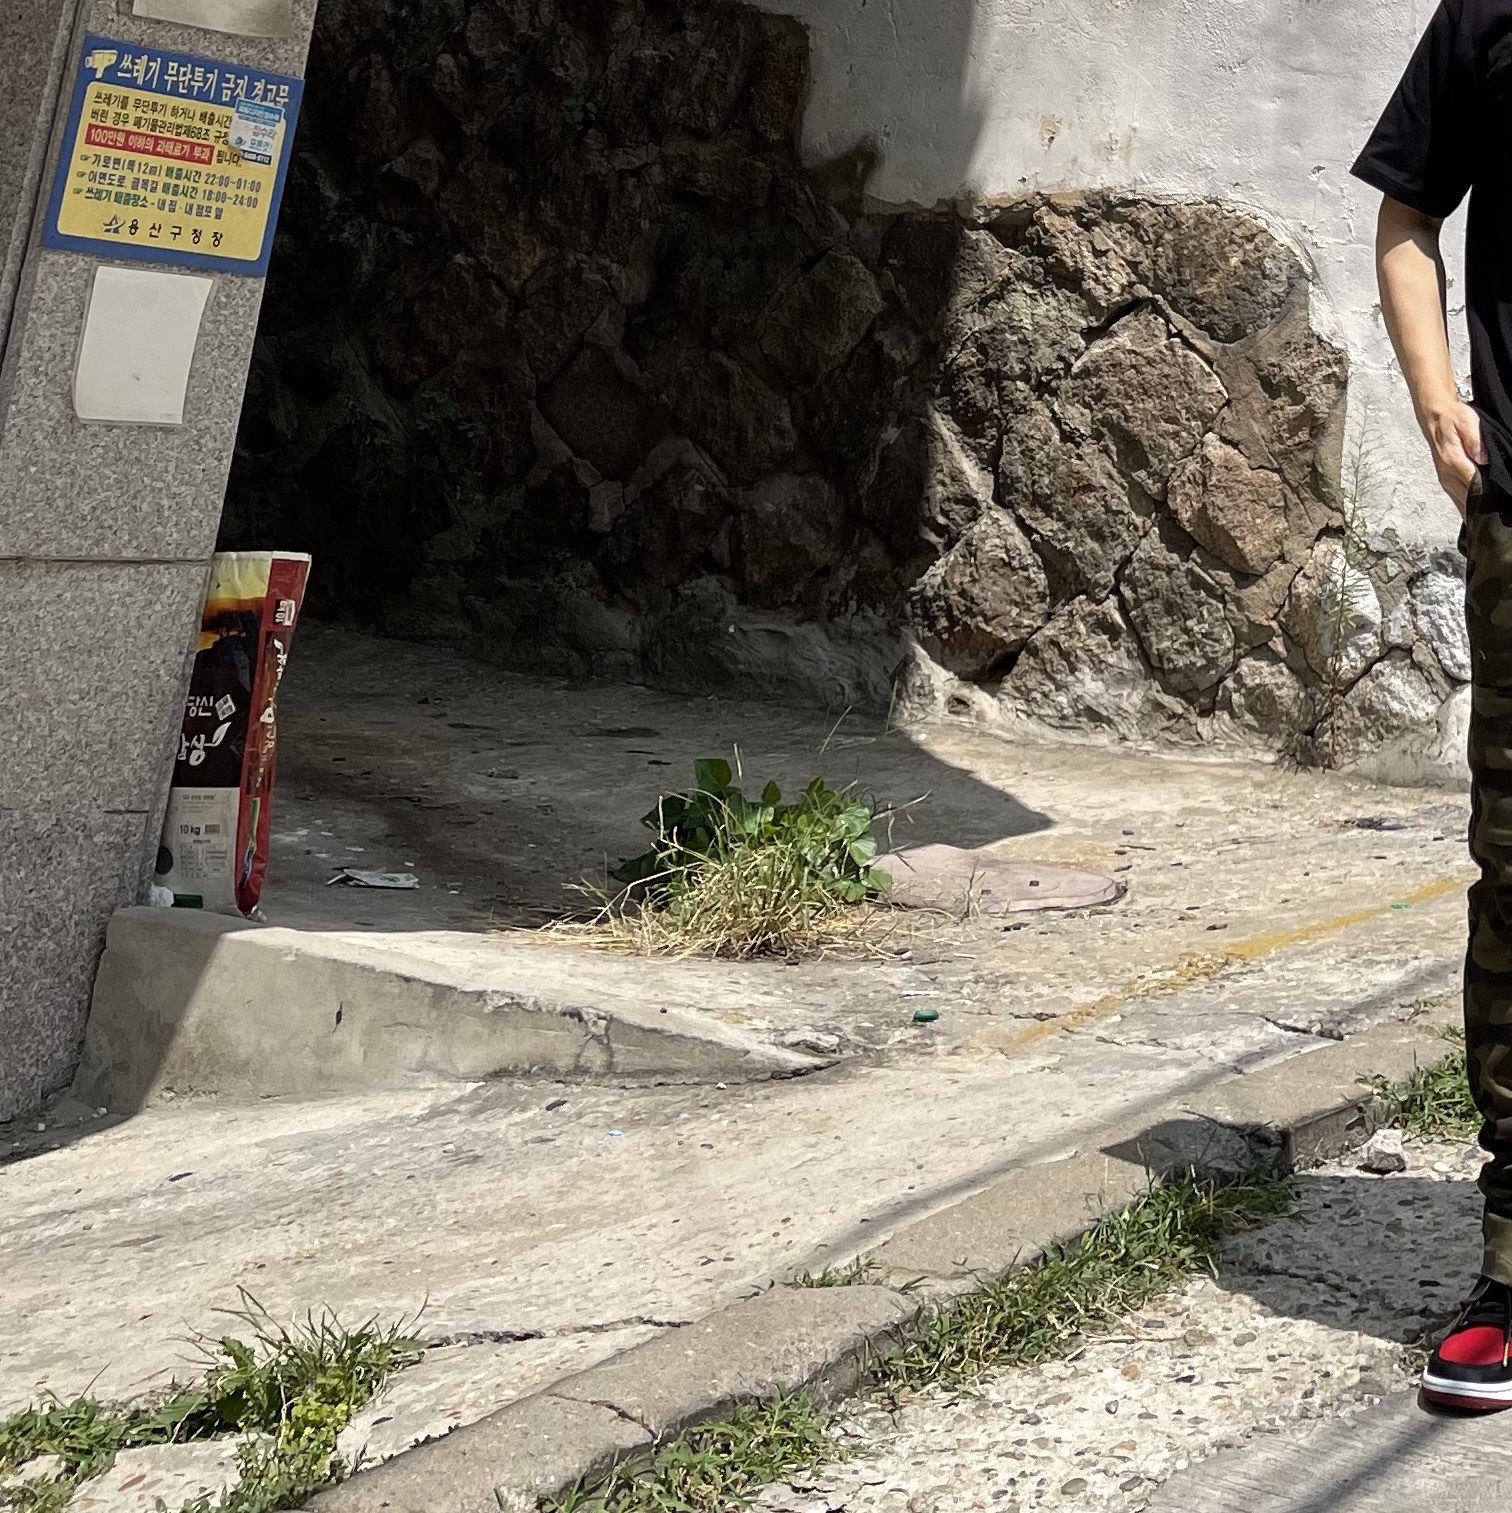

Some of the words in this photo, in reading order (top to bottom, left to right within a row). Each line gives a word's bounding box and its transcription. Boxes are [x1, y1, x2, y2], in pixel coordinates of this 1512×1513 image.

[117, 53, 161, 89] 쓰레기
[164, 61, 218, 100] 무단투기
[221, 72, 248, 102] 금지
[90, 107, 109, 124] 버린
[112, 111, 130, 126] 경우
[93, 91, 130, 110] 쓰레기를
[132, 98, 168, 118] 무단투기
[199, 111, 232, 129] 배출시간
[89, 128, 125, 147] 100만원
[128, 135, 154, 151] 이하의
[193, 146, 210, 161] 부과
[84, 186, 112, 203] 쓰레기
[130, 176, 159, 194] 골목길
[162, 182, 199, 199] 배출시간
[202, 188, 259, 209] 18:00~24:00
[165, 166, 202, 184] 배출시간
[204, 172, 262, 194] 22:00~01:00
[179, 824, 189, 834] 10
[191, 824, 201, 836] kg
